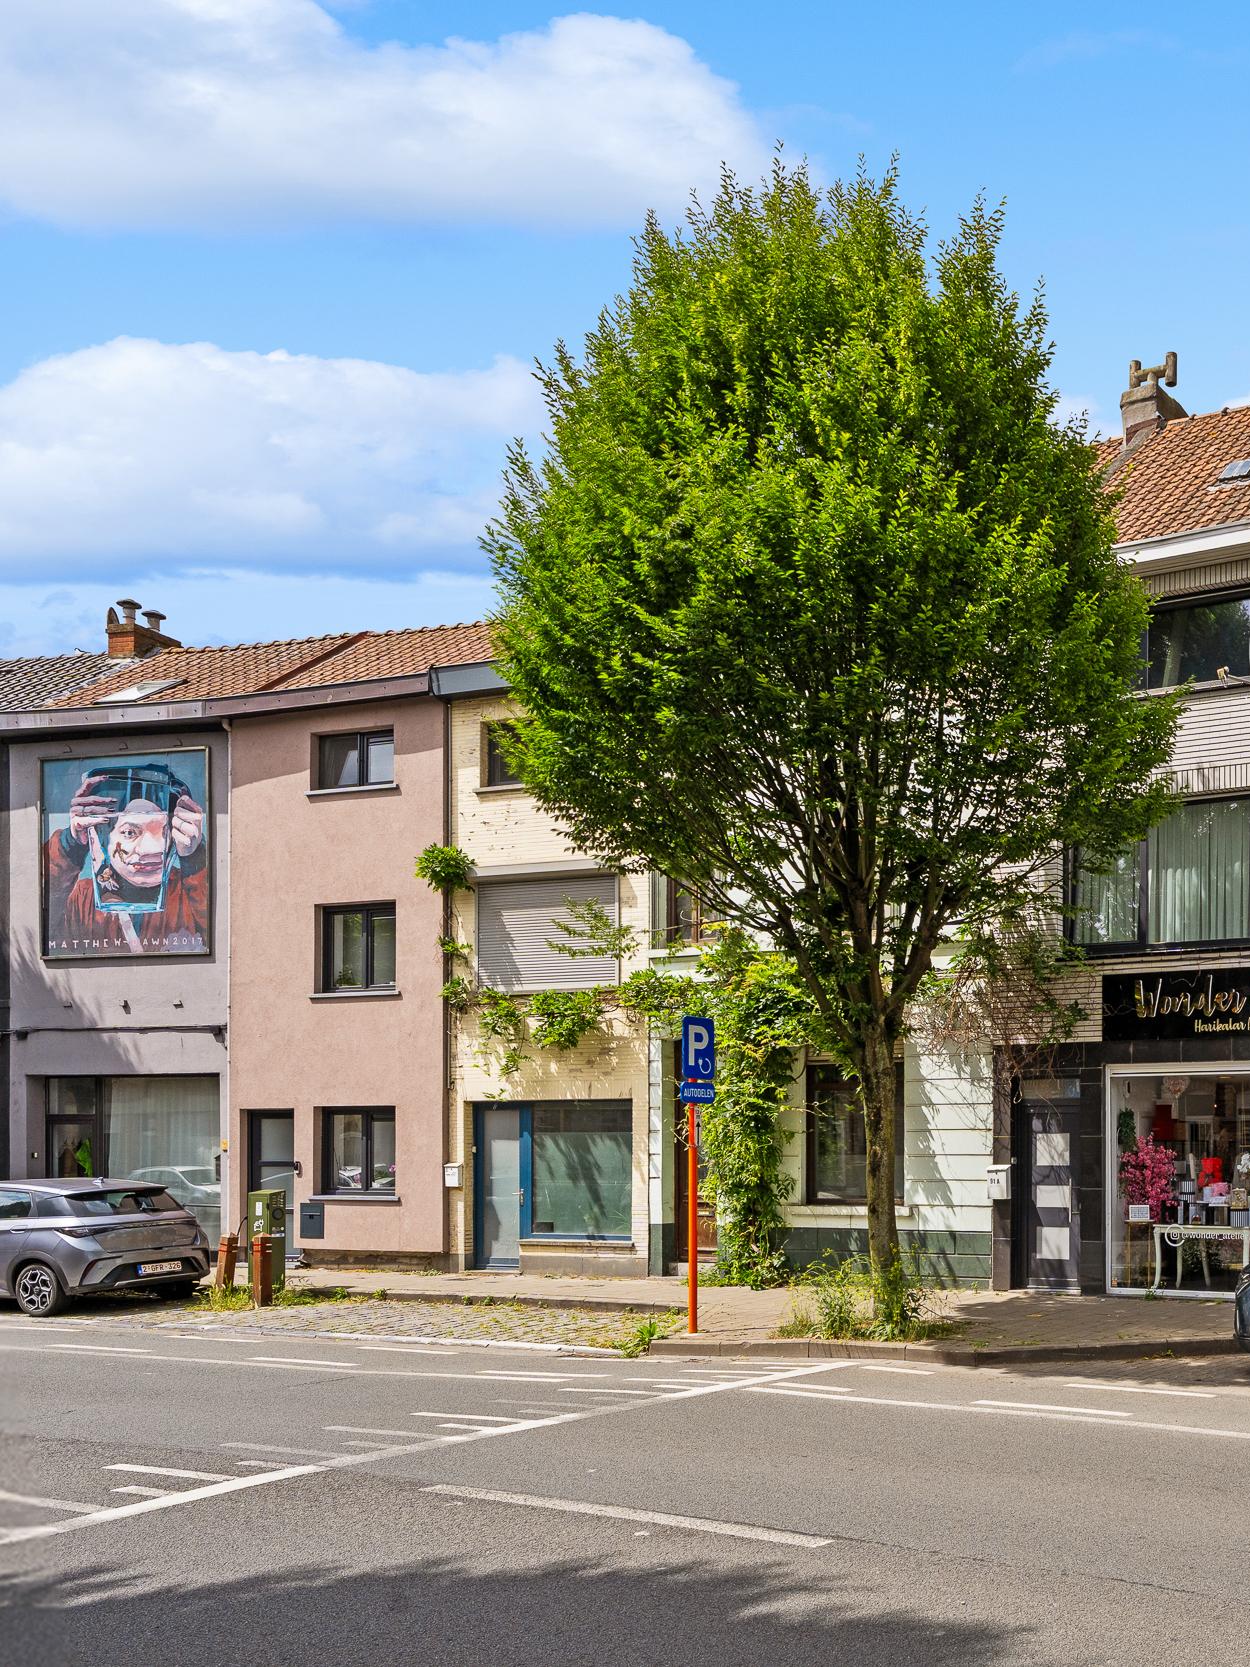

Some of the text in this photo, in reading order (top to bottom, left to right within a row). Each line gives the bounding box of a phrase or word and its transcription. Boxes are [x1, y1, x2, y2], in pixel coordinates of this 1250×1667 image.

[1134, 974, 1247, 1018] Wonder
[1194, 1018, 1247, 1033] Harikalar
[688, 1024, 709, 1066] P
[683, 1087, 714, 1098] AUTODELEN
[1182, 1231, 1249, 1241] @wonder_atelie
